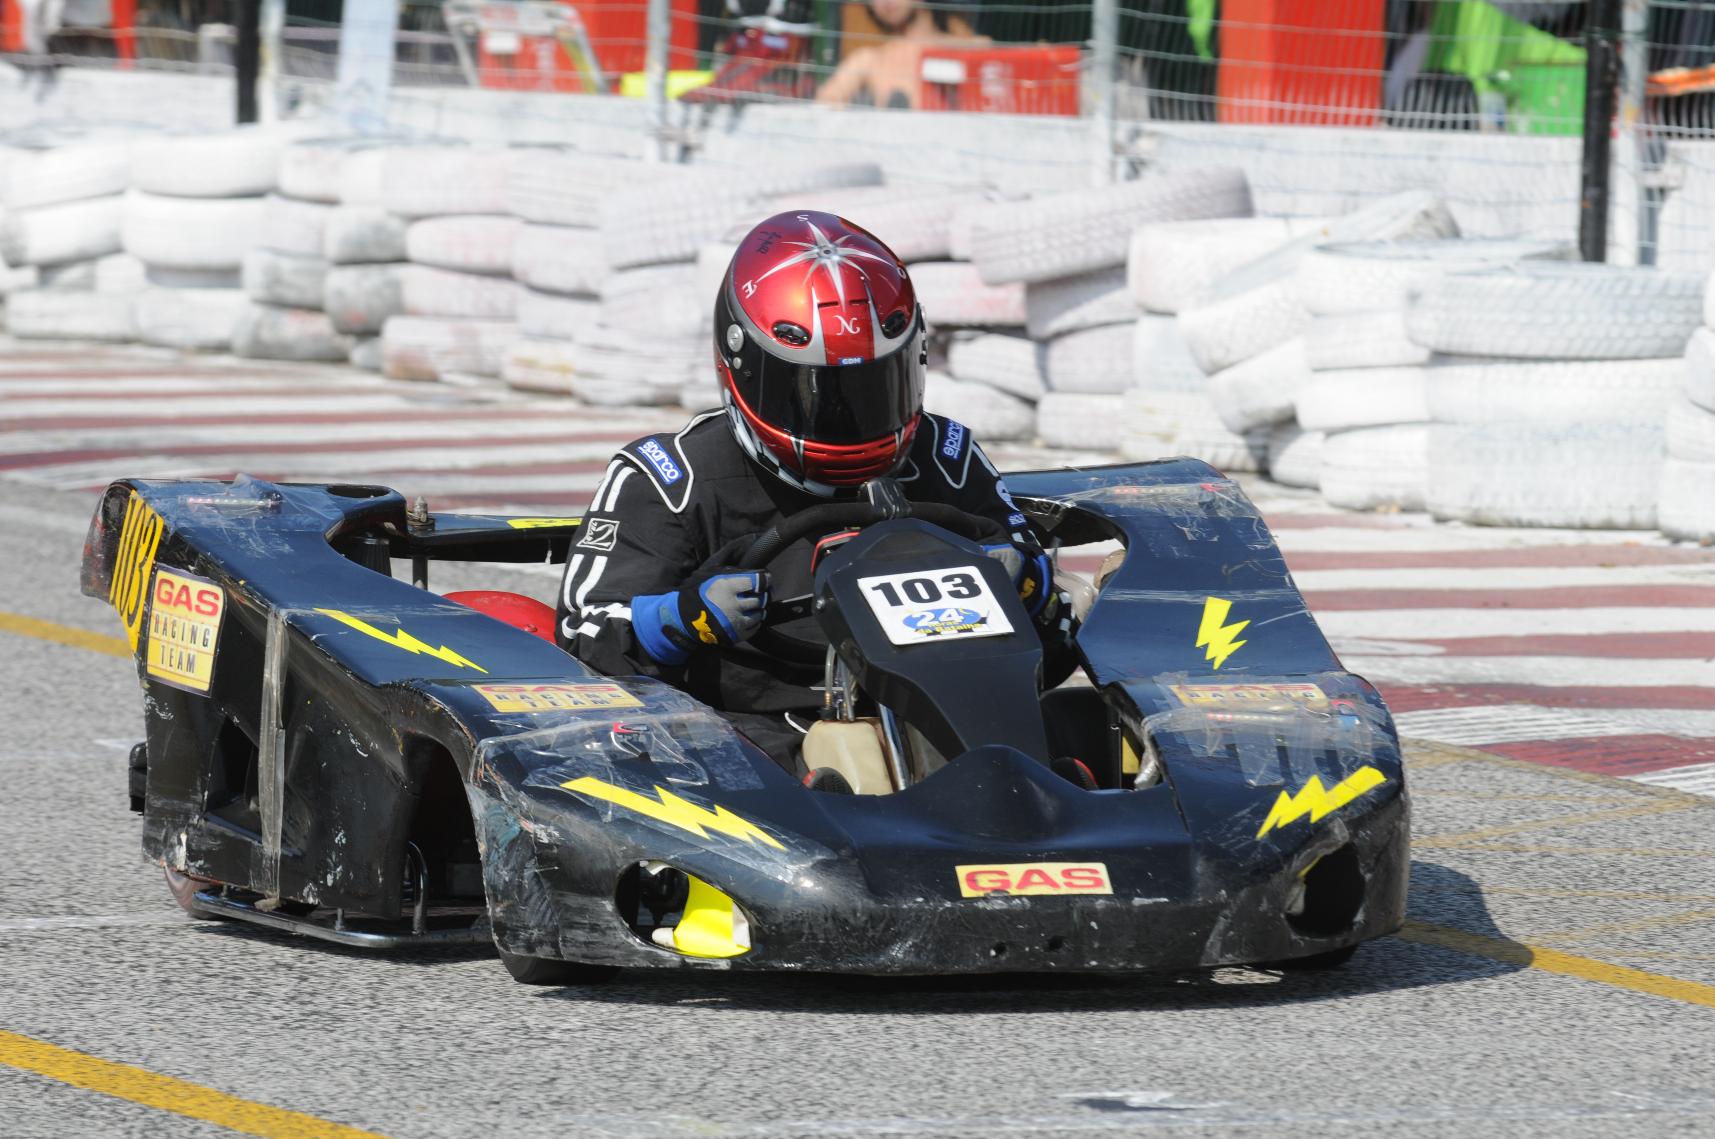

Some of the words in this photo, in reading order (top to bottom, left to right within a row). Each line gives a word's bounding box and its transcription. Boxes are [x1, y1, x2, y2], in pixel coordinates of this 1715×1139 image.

[832, 314, 861, 336] N
[642, 440, 679, 480] sparco
[110, 496, 158, 629] 103
[155, 577, 220, 618] GAS
[871, 573, 982, 607] 103
[153, 612, 212, 649] RACING
[911, 612, 965, 627] 24
[160, 643, 197, 675] TEAM
[481, 685, 618, 693] GAS
[965, 867, 1105, 892] GAS
